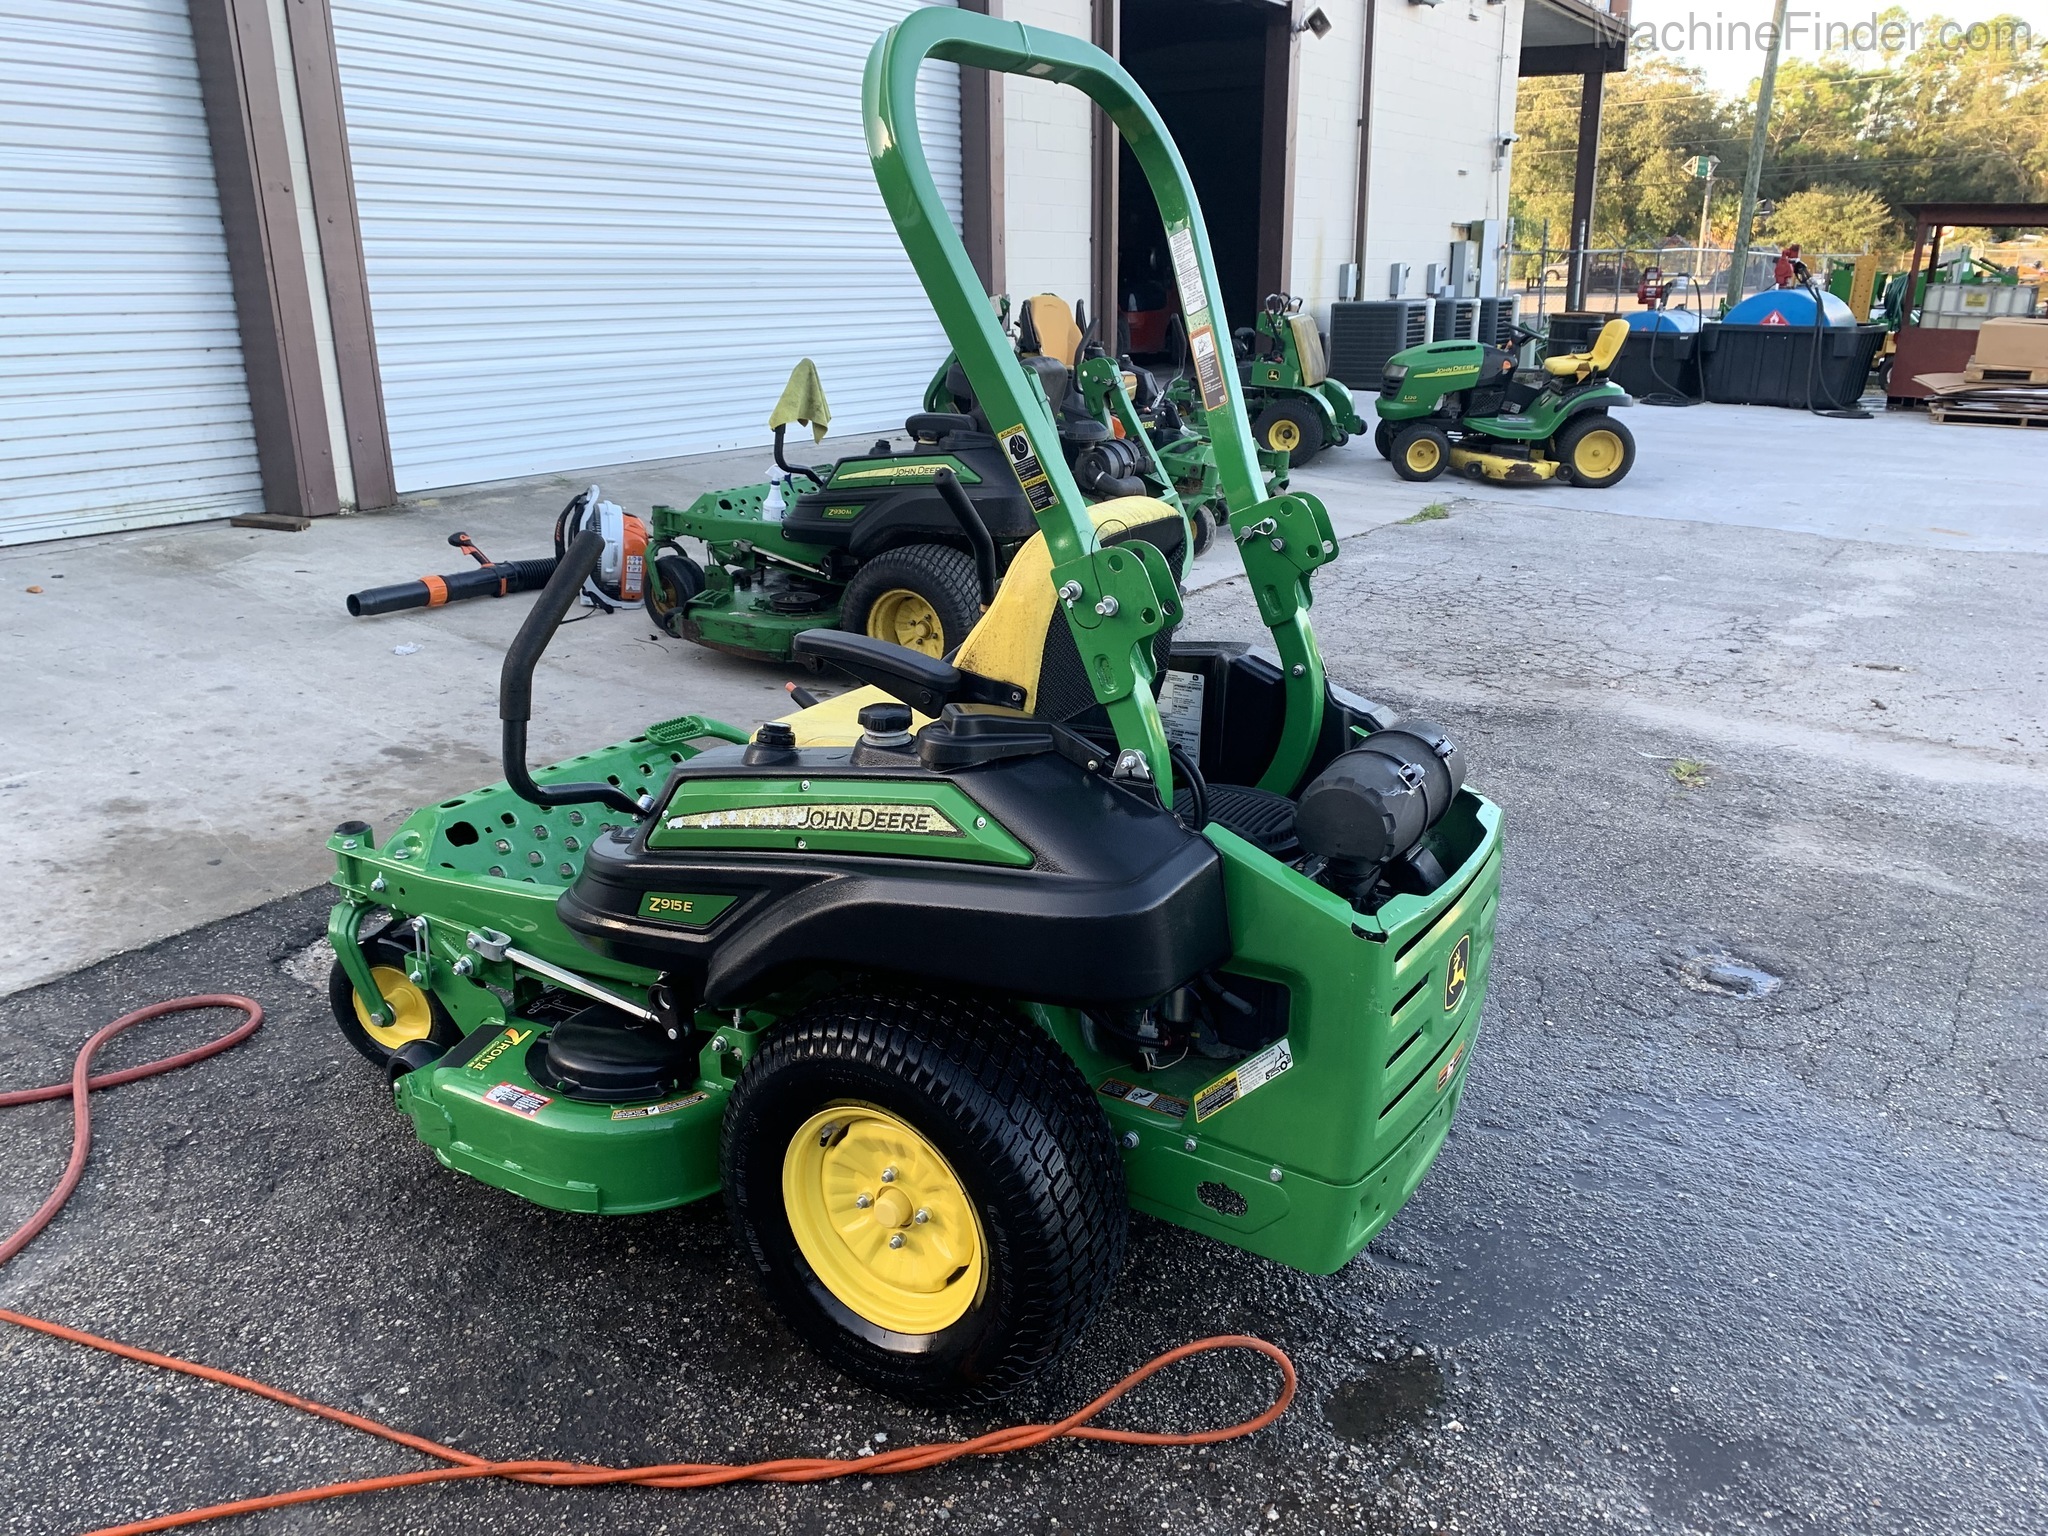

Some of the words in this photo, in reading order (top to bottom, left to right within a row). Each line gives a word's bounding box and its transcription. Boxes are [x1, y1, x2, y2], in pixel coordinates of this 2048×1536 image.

[1434, 366, 1453, 375] JOHN
[1453, 364, 1475, 372] DEERE
[1004, 425, 1022, 435] CAUTION
[893, 467, 917, 477] JOHN
[828, 508, 852, 516] Z930M
[797, 806, 854, 830] JOHN
[857, 808, 930, 831] DEERE
[648, 897, 693, 914] Z915E
[481, 1040, 514, 1064] IRON
